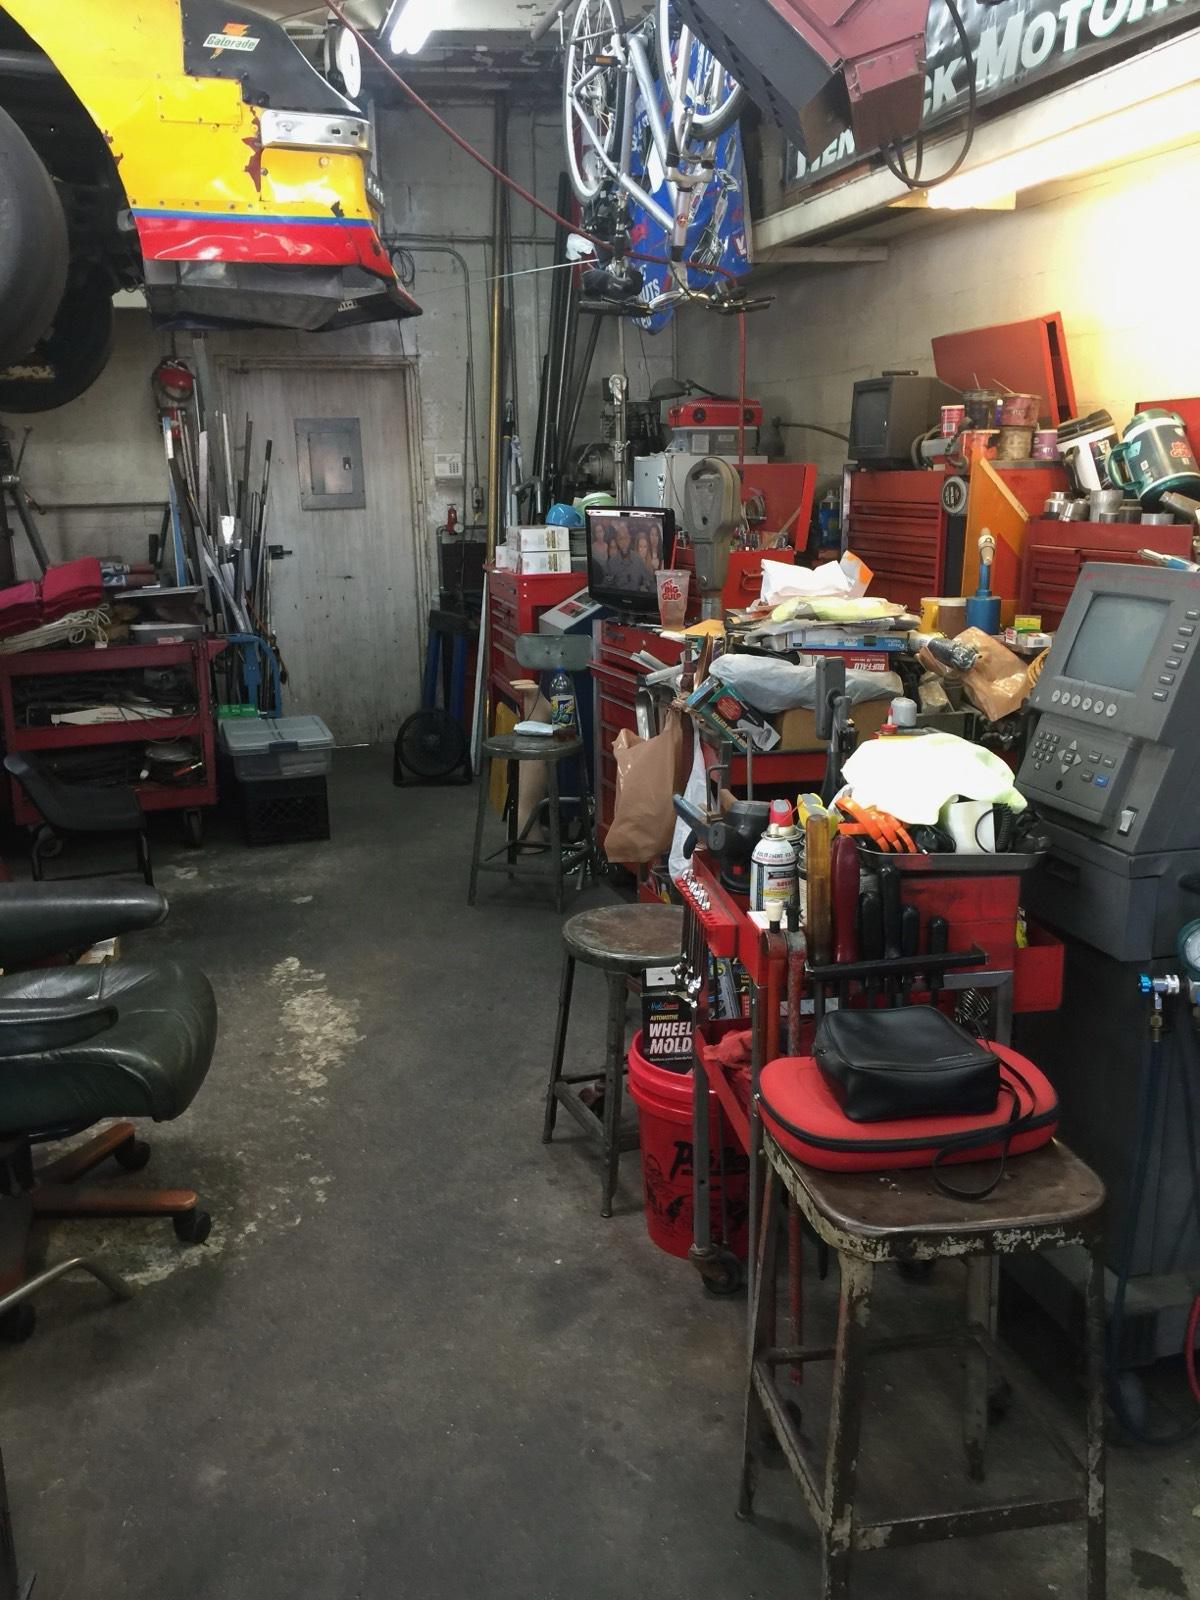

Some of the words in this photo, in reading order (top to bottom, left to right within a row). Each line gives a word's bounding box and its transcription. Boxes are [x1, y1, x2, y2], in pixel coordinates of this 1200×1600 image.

[207, 36, 255, 49] Gatorade
[662, 592, 682, 601] GULP
[854, 662, 886, 672] BUFFALO
[649, 1022, 692, 1037] WHEEL
[649, 1038, 692, 1054] MOLD
